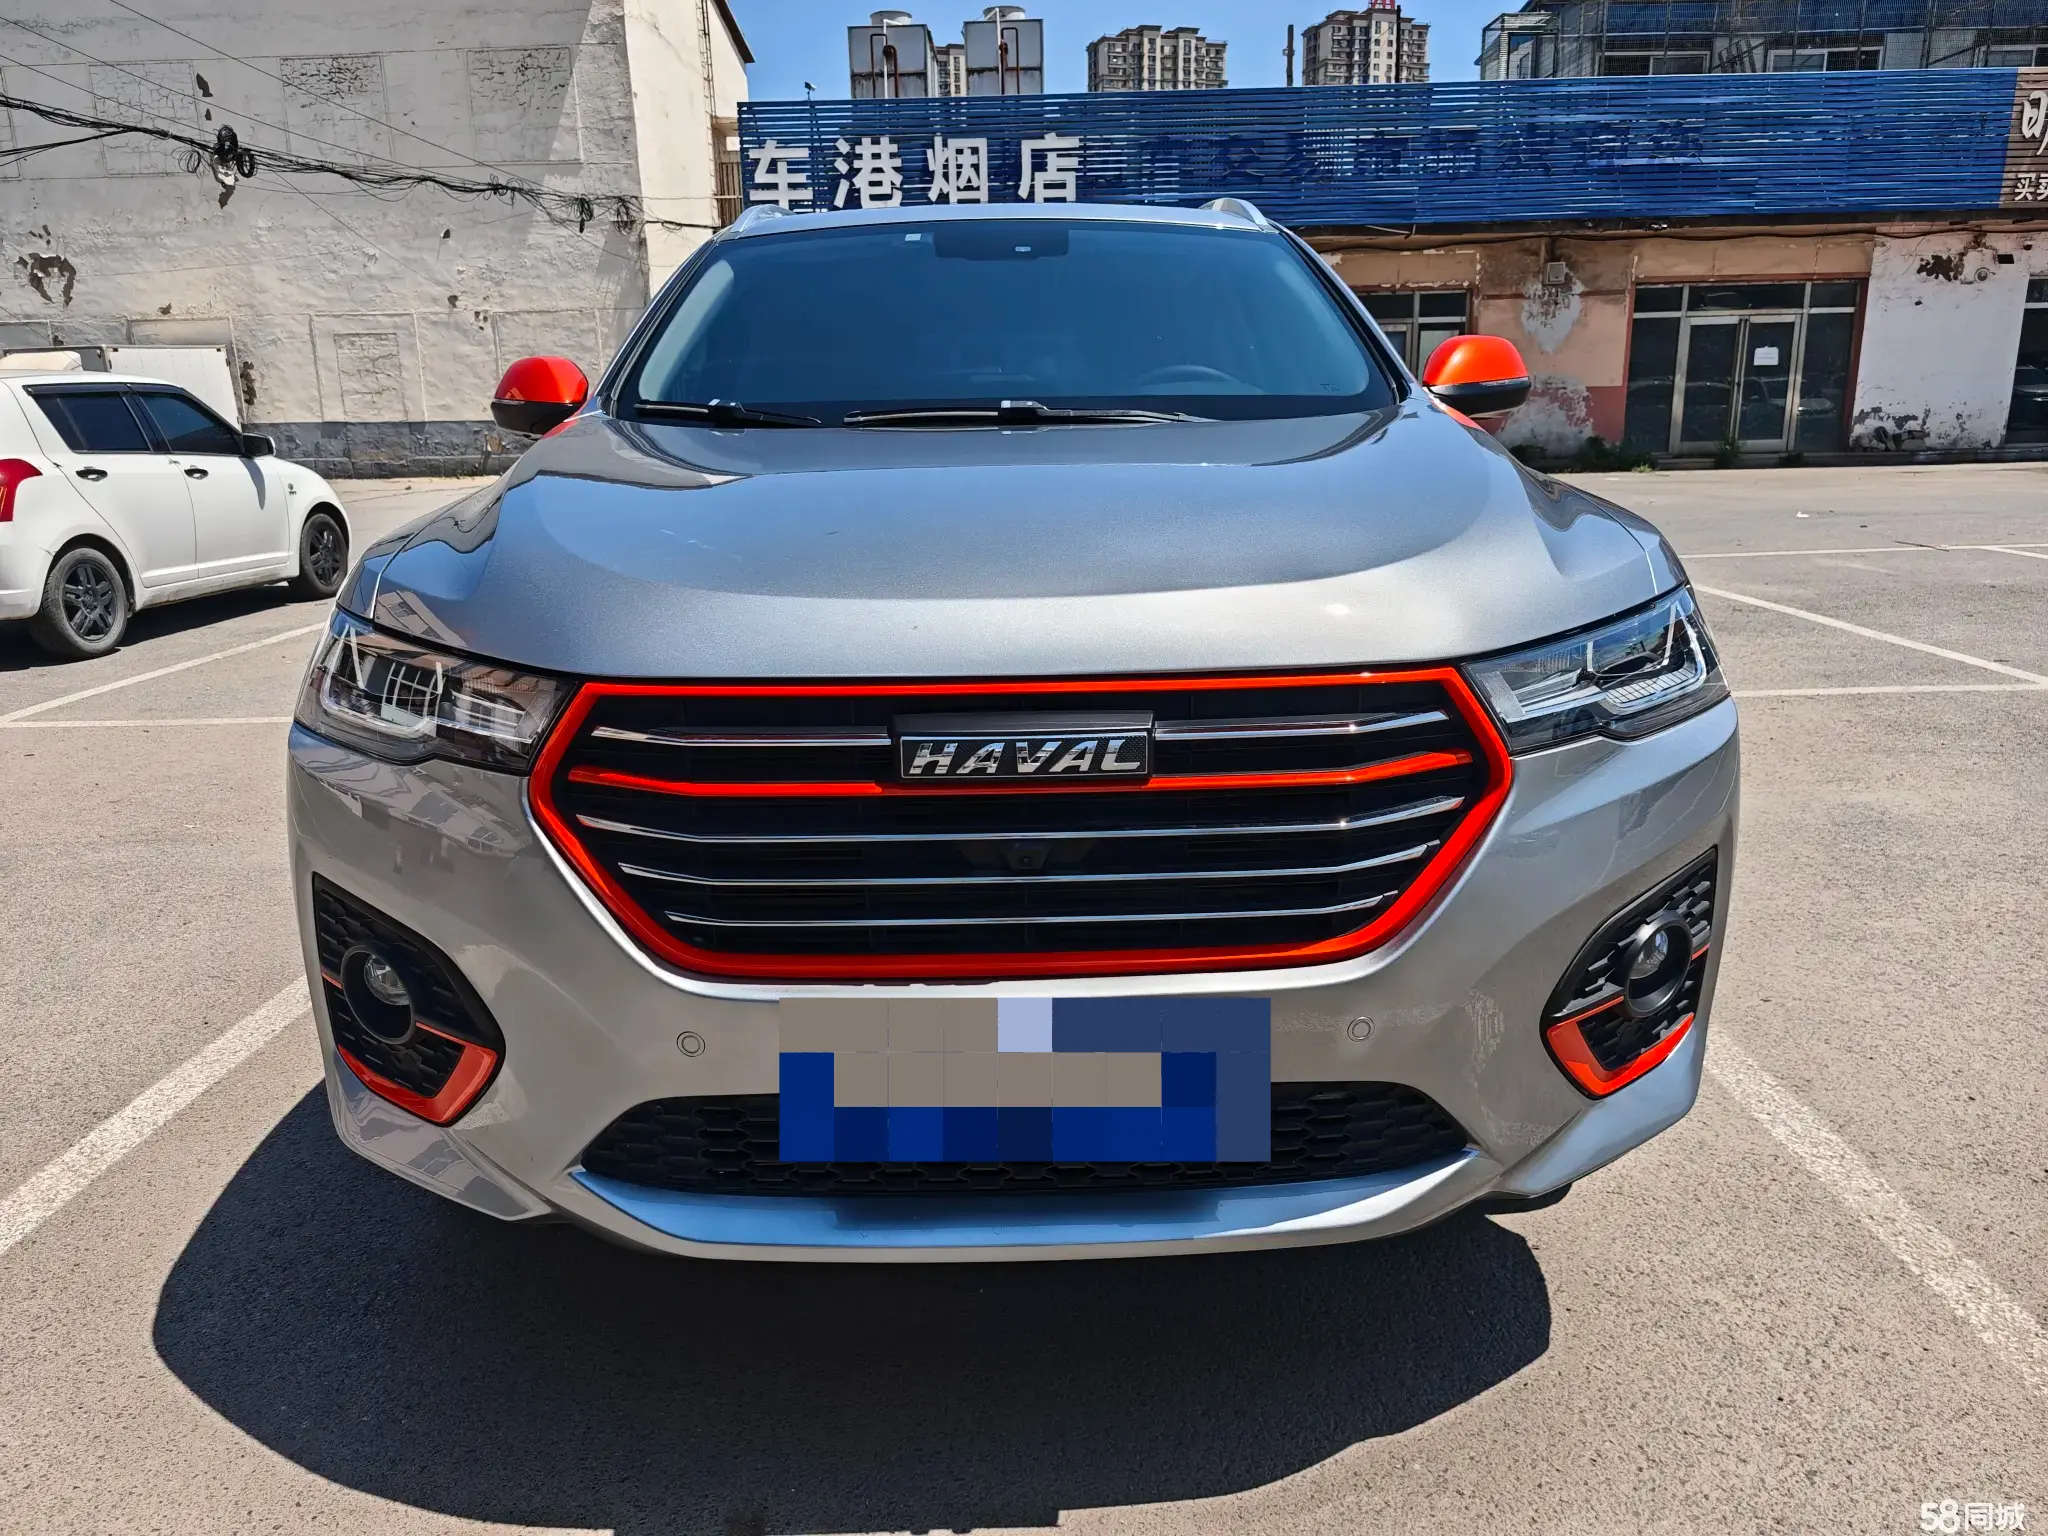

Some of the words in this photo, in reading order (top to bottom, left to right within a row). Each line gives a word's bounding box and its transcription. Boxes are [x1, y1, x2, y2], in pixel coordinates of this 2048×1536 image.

[748, 132, 1080, 209] 车港烟店
[908, 740, 1141, 774] HAVAL
